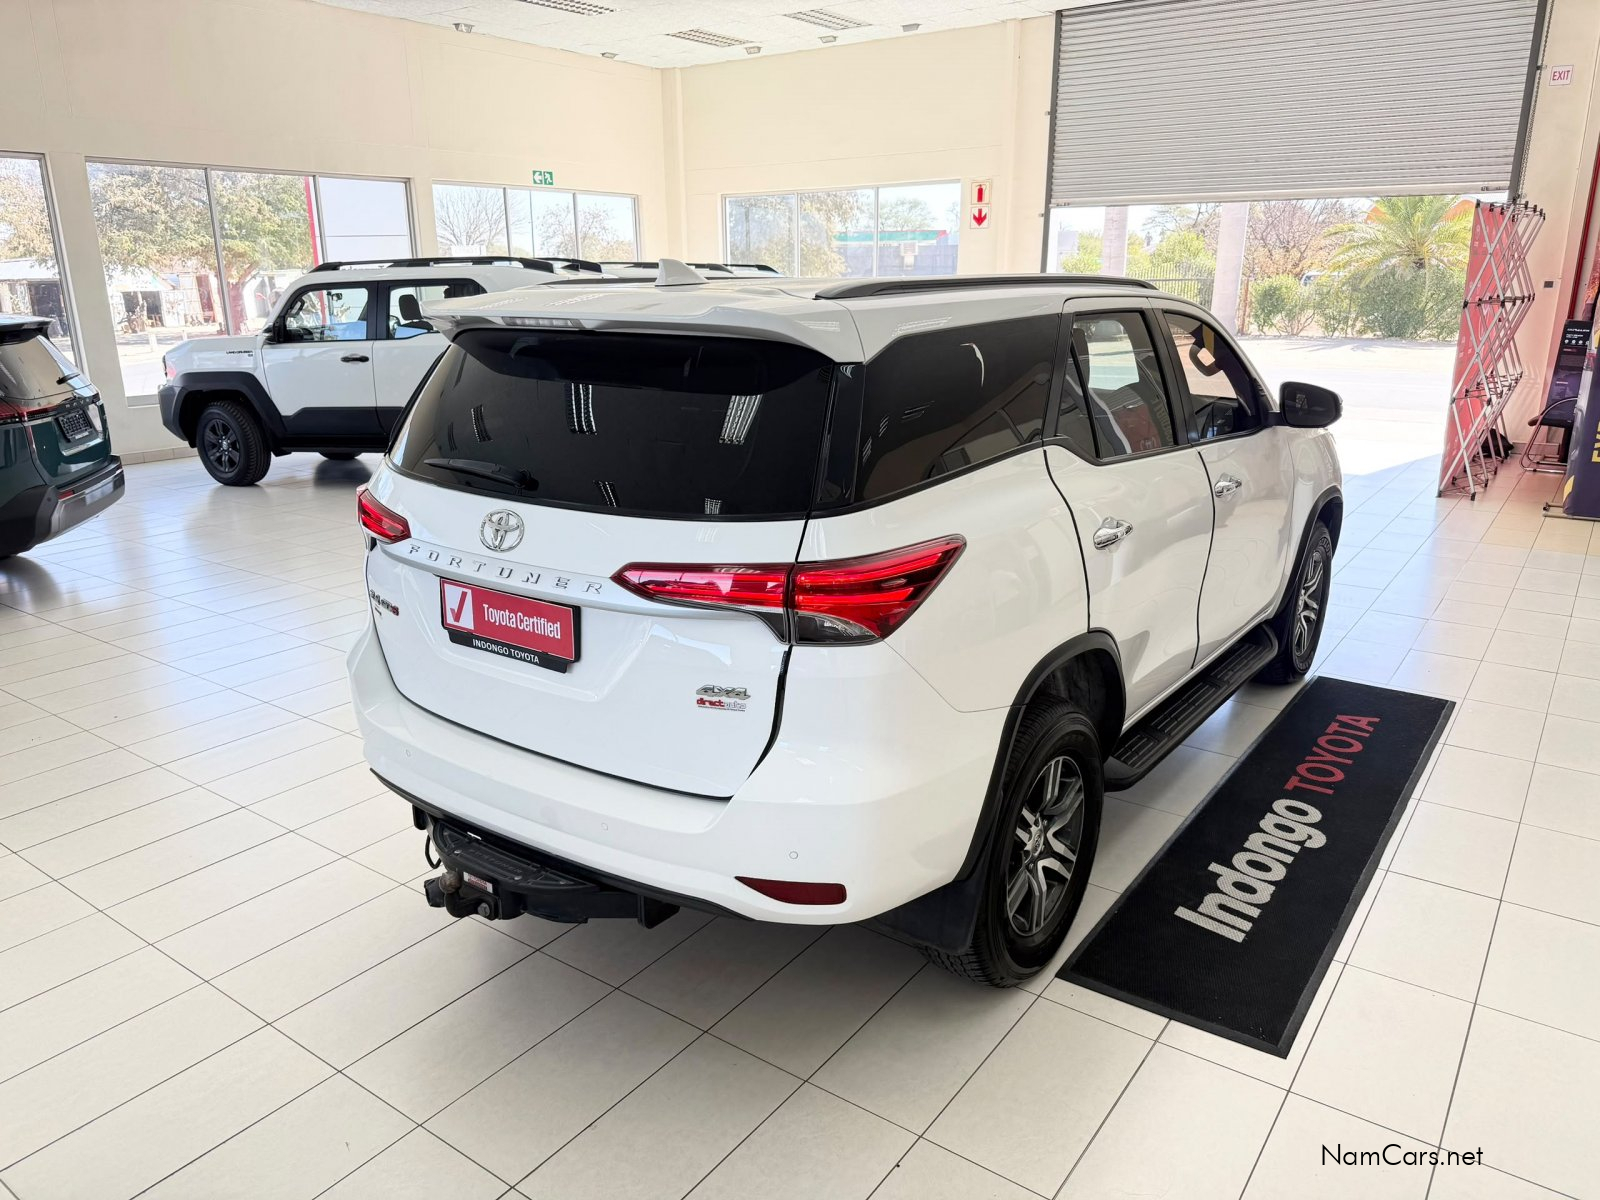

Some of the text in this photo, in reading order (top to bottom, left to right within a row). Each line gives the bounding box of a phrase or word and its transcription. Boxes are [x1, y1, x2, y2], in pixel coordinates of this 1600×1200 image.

[1552, 70, 1571, 81] EXIT
[408, 543, 604, 595] FORTUNER
[483, 603, 561, 639] Toyota Certified
[472, 638, 540, 664] INDONGO TOYOTA
[1173, 714, 1381, 944] Indongo TOYOTA
